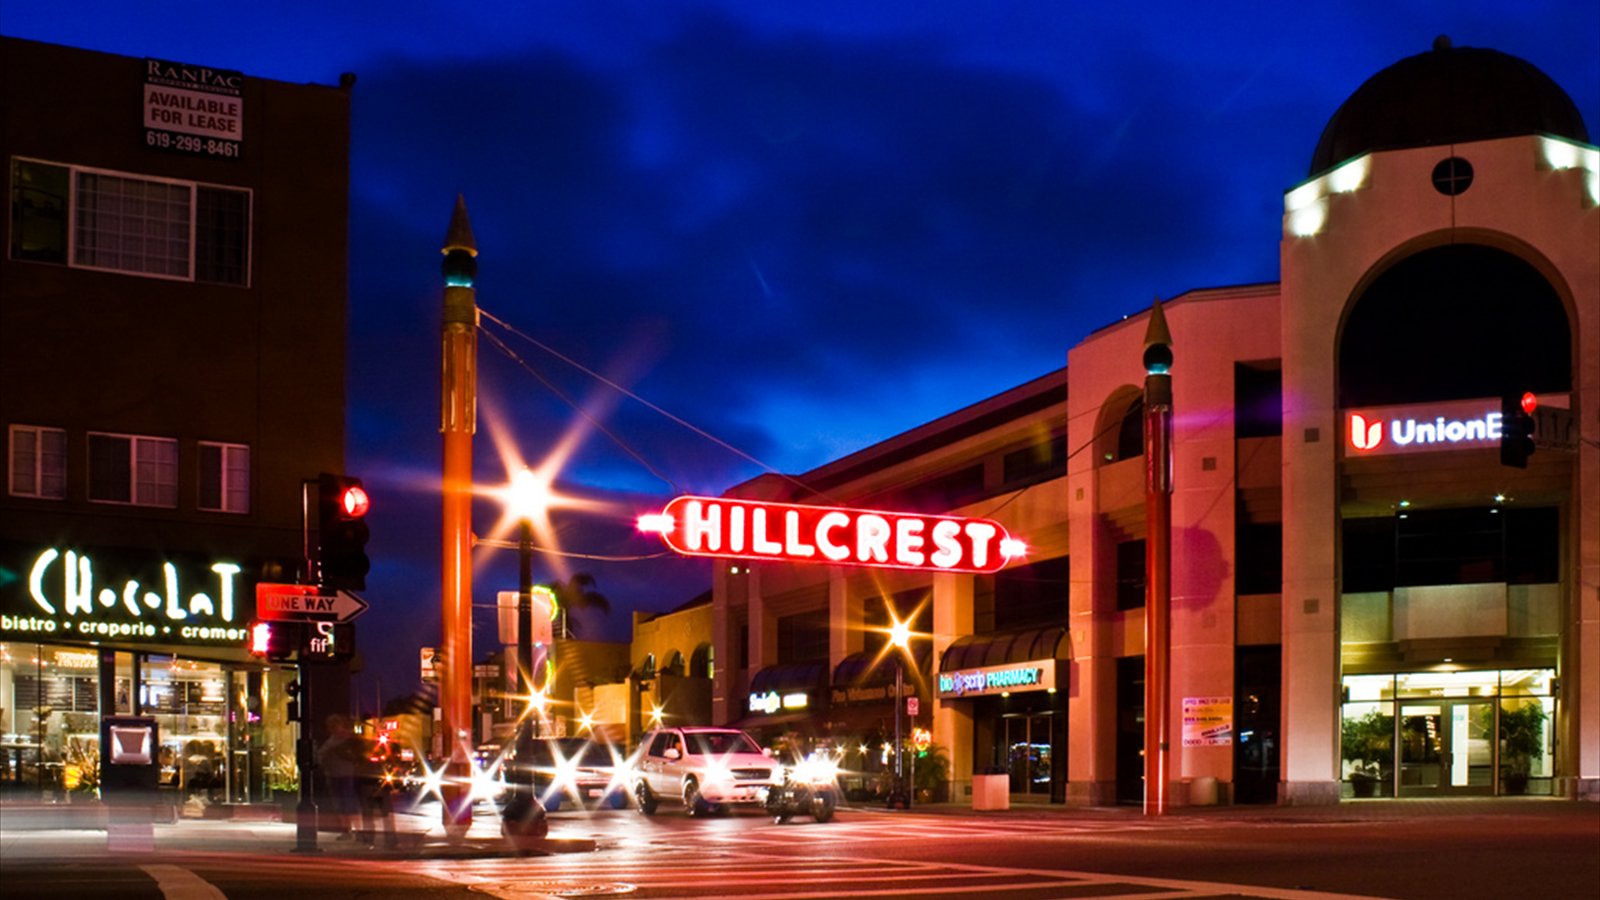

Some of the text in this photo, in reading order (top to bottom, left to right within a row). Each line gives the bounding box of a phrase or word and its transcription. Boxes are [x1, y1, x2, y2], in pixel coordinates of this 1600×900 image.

[149, 91, 238, 117] AVAILABLE
[151, 108, 236, 133] FOR LEASE
[146, 131, 238, 157] 619-299-8461
[685, 501, 996, 568] HILLCREST
[270, 596, 335, 610] ONE WAY
[1, 614, 56, 632] bistro
[181, 624, 249, 640] cremer
[310, 638, 329, 652] fif
[986, 668, 1037, 687] PHARMACY
